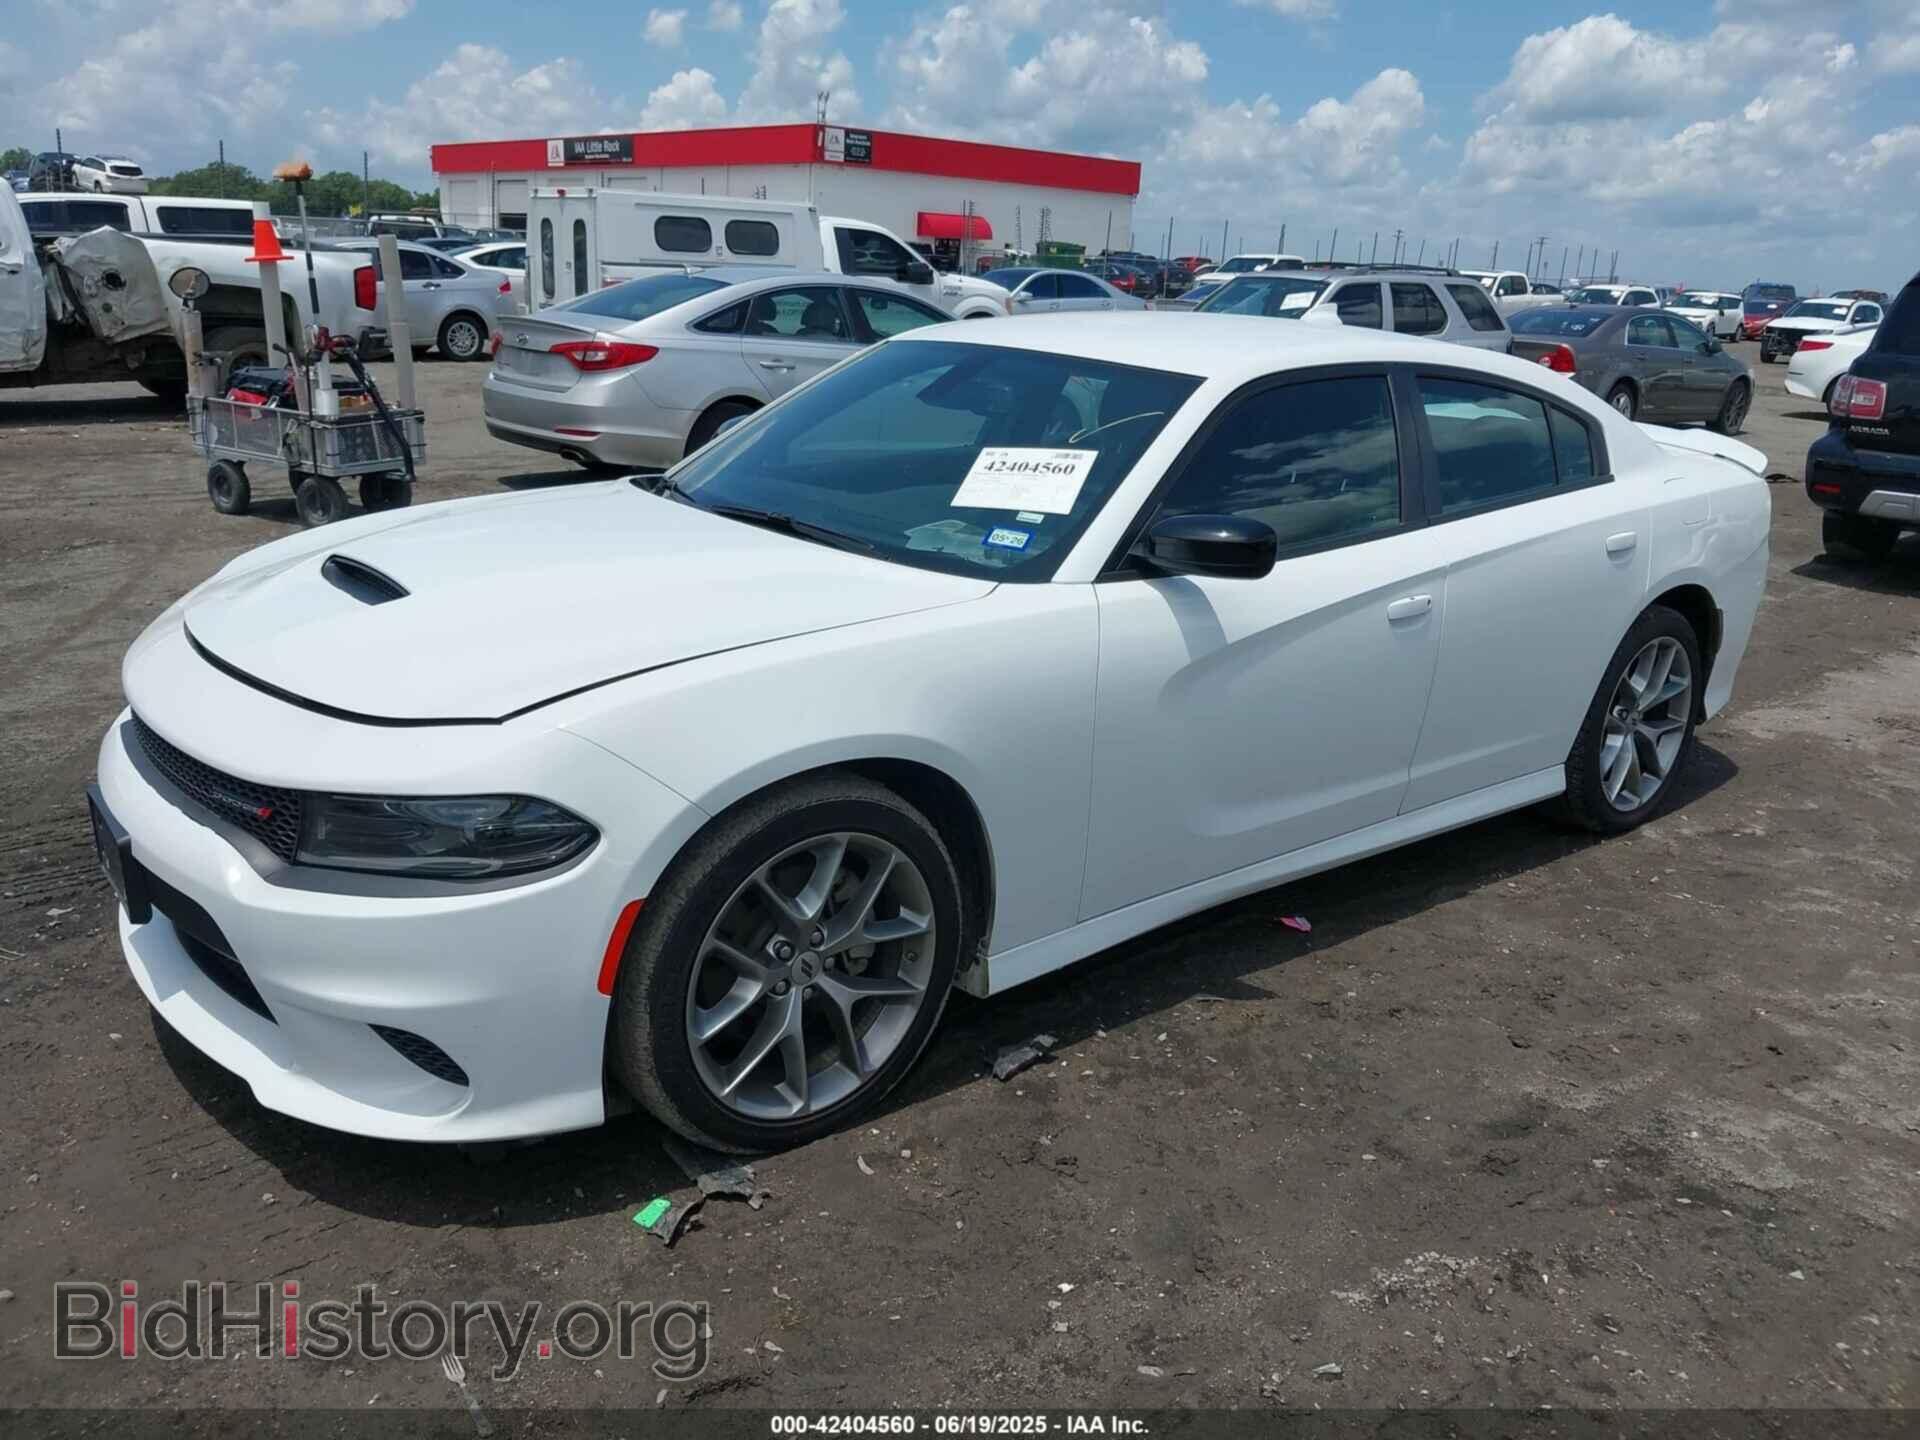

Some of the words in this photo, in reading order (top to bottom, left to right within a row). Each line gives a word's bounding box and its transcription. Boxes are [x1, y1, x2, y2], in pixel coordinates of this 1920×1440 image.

[586, 140, 602, 153] Little
[603, 139, 620, 153] Rock
[984, 459, 1076, 476] 42404560
